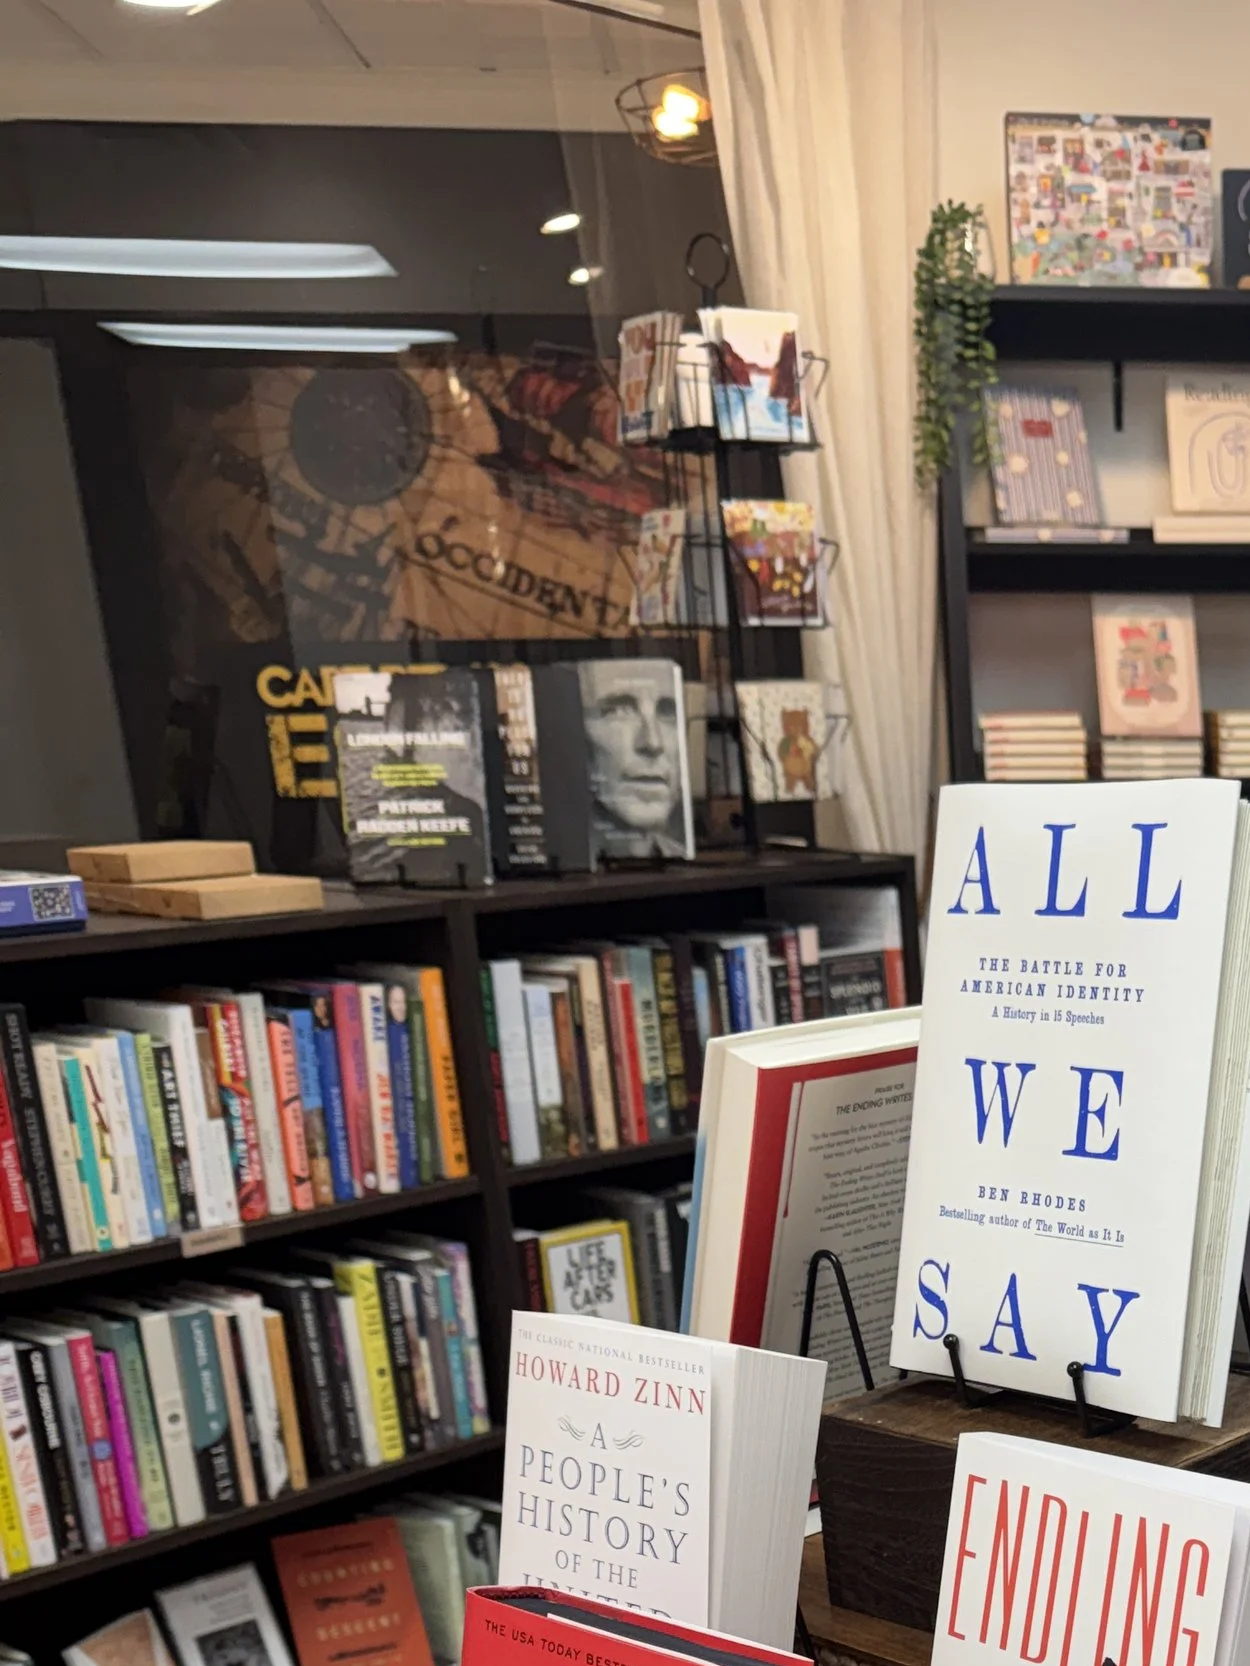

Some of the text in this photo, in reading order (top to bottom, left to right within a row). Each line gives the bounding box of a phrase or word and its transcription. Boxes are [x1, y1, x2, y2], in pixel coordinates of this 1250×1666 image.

[346, 731, 469, 748] LONDON FALLING
[378, 800, 445, 815] PATRICK
[357, 817, 470, 834] RADDEN KEEFE
[947, 822, 1183, 920] ALL
[979, 957, 1127, 978] THE BATTLE FOR
[960, 979, 1145, 1003] AMERICAN IDENTITY
[992, 1005, 1105, 1026] A History in 15 Speeches
[641, 999, 665, 1105] MURDERLAND
[162, 1068, 186, 1148] ART THIEF
[836, 1103, 851, 1116] THE
[852, 1098, 883, 1113] ENDING
[965, 1057, 1125, 1161] WE
[449, 1109, 466, 1146] GIRL
[978, 1185, 1087, 1212] BEN RHODES
[566, 1243, 606, 1266] LIFE
[564, 1262, 617, 1293] AFTER
[570, 1284, 614, 1311] CARS
[913, 1259, 1141, 1377] SAY
[518, 1329, 705, 1376] THE CLASSIC NATIONAL BESTSELLER
[515, 1352, 707, 1416] HOWARD ZINN
[590, 1423, 608, 1450] A
[519, 1445, 690, 1517] PEOPLE'S
[518, 1491, 688, 1565] HISTORY
[555, 1549, 638, 1589] OF THE
[484, 1619, 507, 1639] THE
[511, 1627, 536, 1648] USA
[539, 1634, 582, 1662] TODAY
